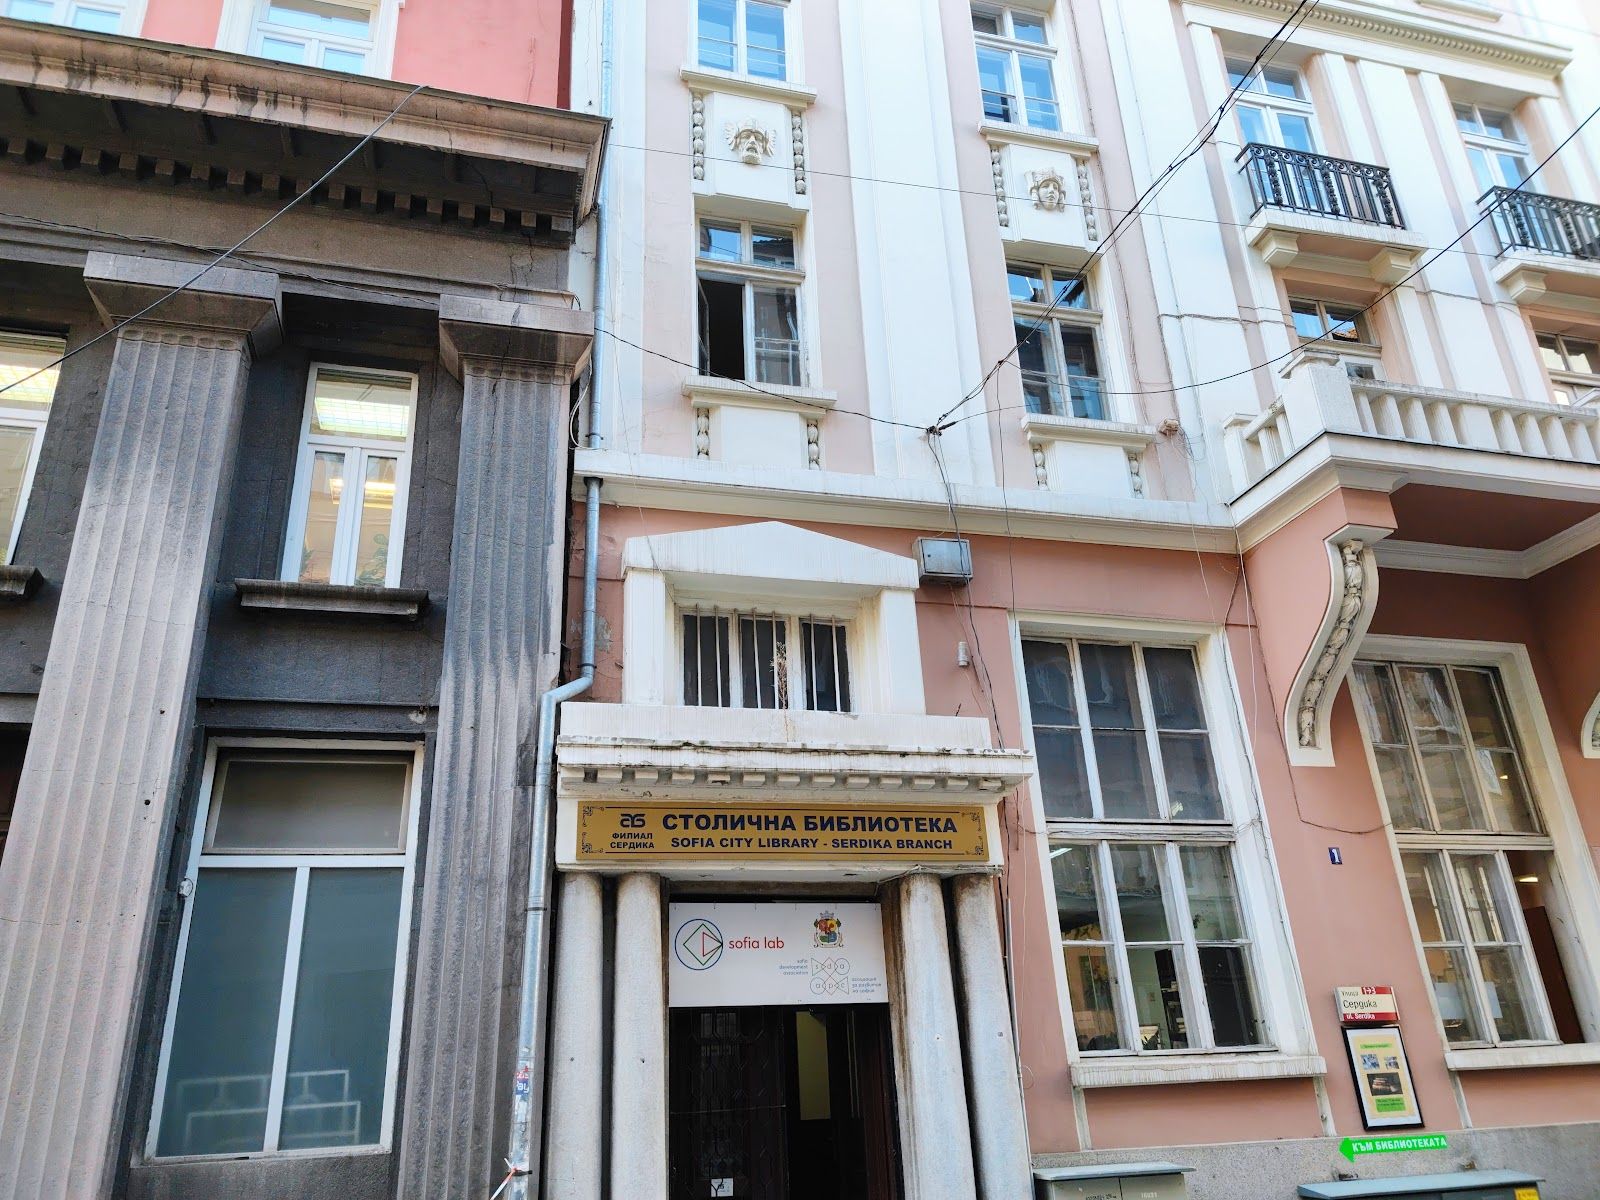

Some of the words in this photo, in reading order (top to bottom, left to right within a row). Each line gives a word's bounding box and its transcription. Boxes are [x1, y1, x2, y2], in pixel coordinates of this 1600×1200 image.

[662, 814, 796, 831] СТОЛИЧНА
[804, 815, 957, 833] БИБЛИОТЕКА
[611, 832, 653, 841] ФИЛИАЛ
[610, 841, 655, 850] СЕРДИКА
[671, 837, 715, 848] SOFIA
[719, 837, 753, 848] CITY
[758, 838, 818, 849] LIBRARY
[832, 838, 892, 849] SERDIKA
[896, 839, 953, 850] BRANCH
[1332, 849, 1339, 862] 1
[728, 936, 760, 950] sofia
[764, 936, 785, 950] lab
[1343, 999, 1378, 1010] Сердика
[1352, 1141, 1374, 1153] КЪМ
[1375, 1137, 1448, 1151] БИБЛИОТЕКАТА
